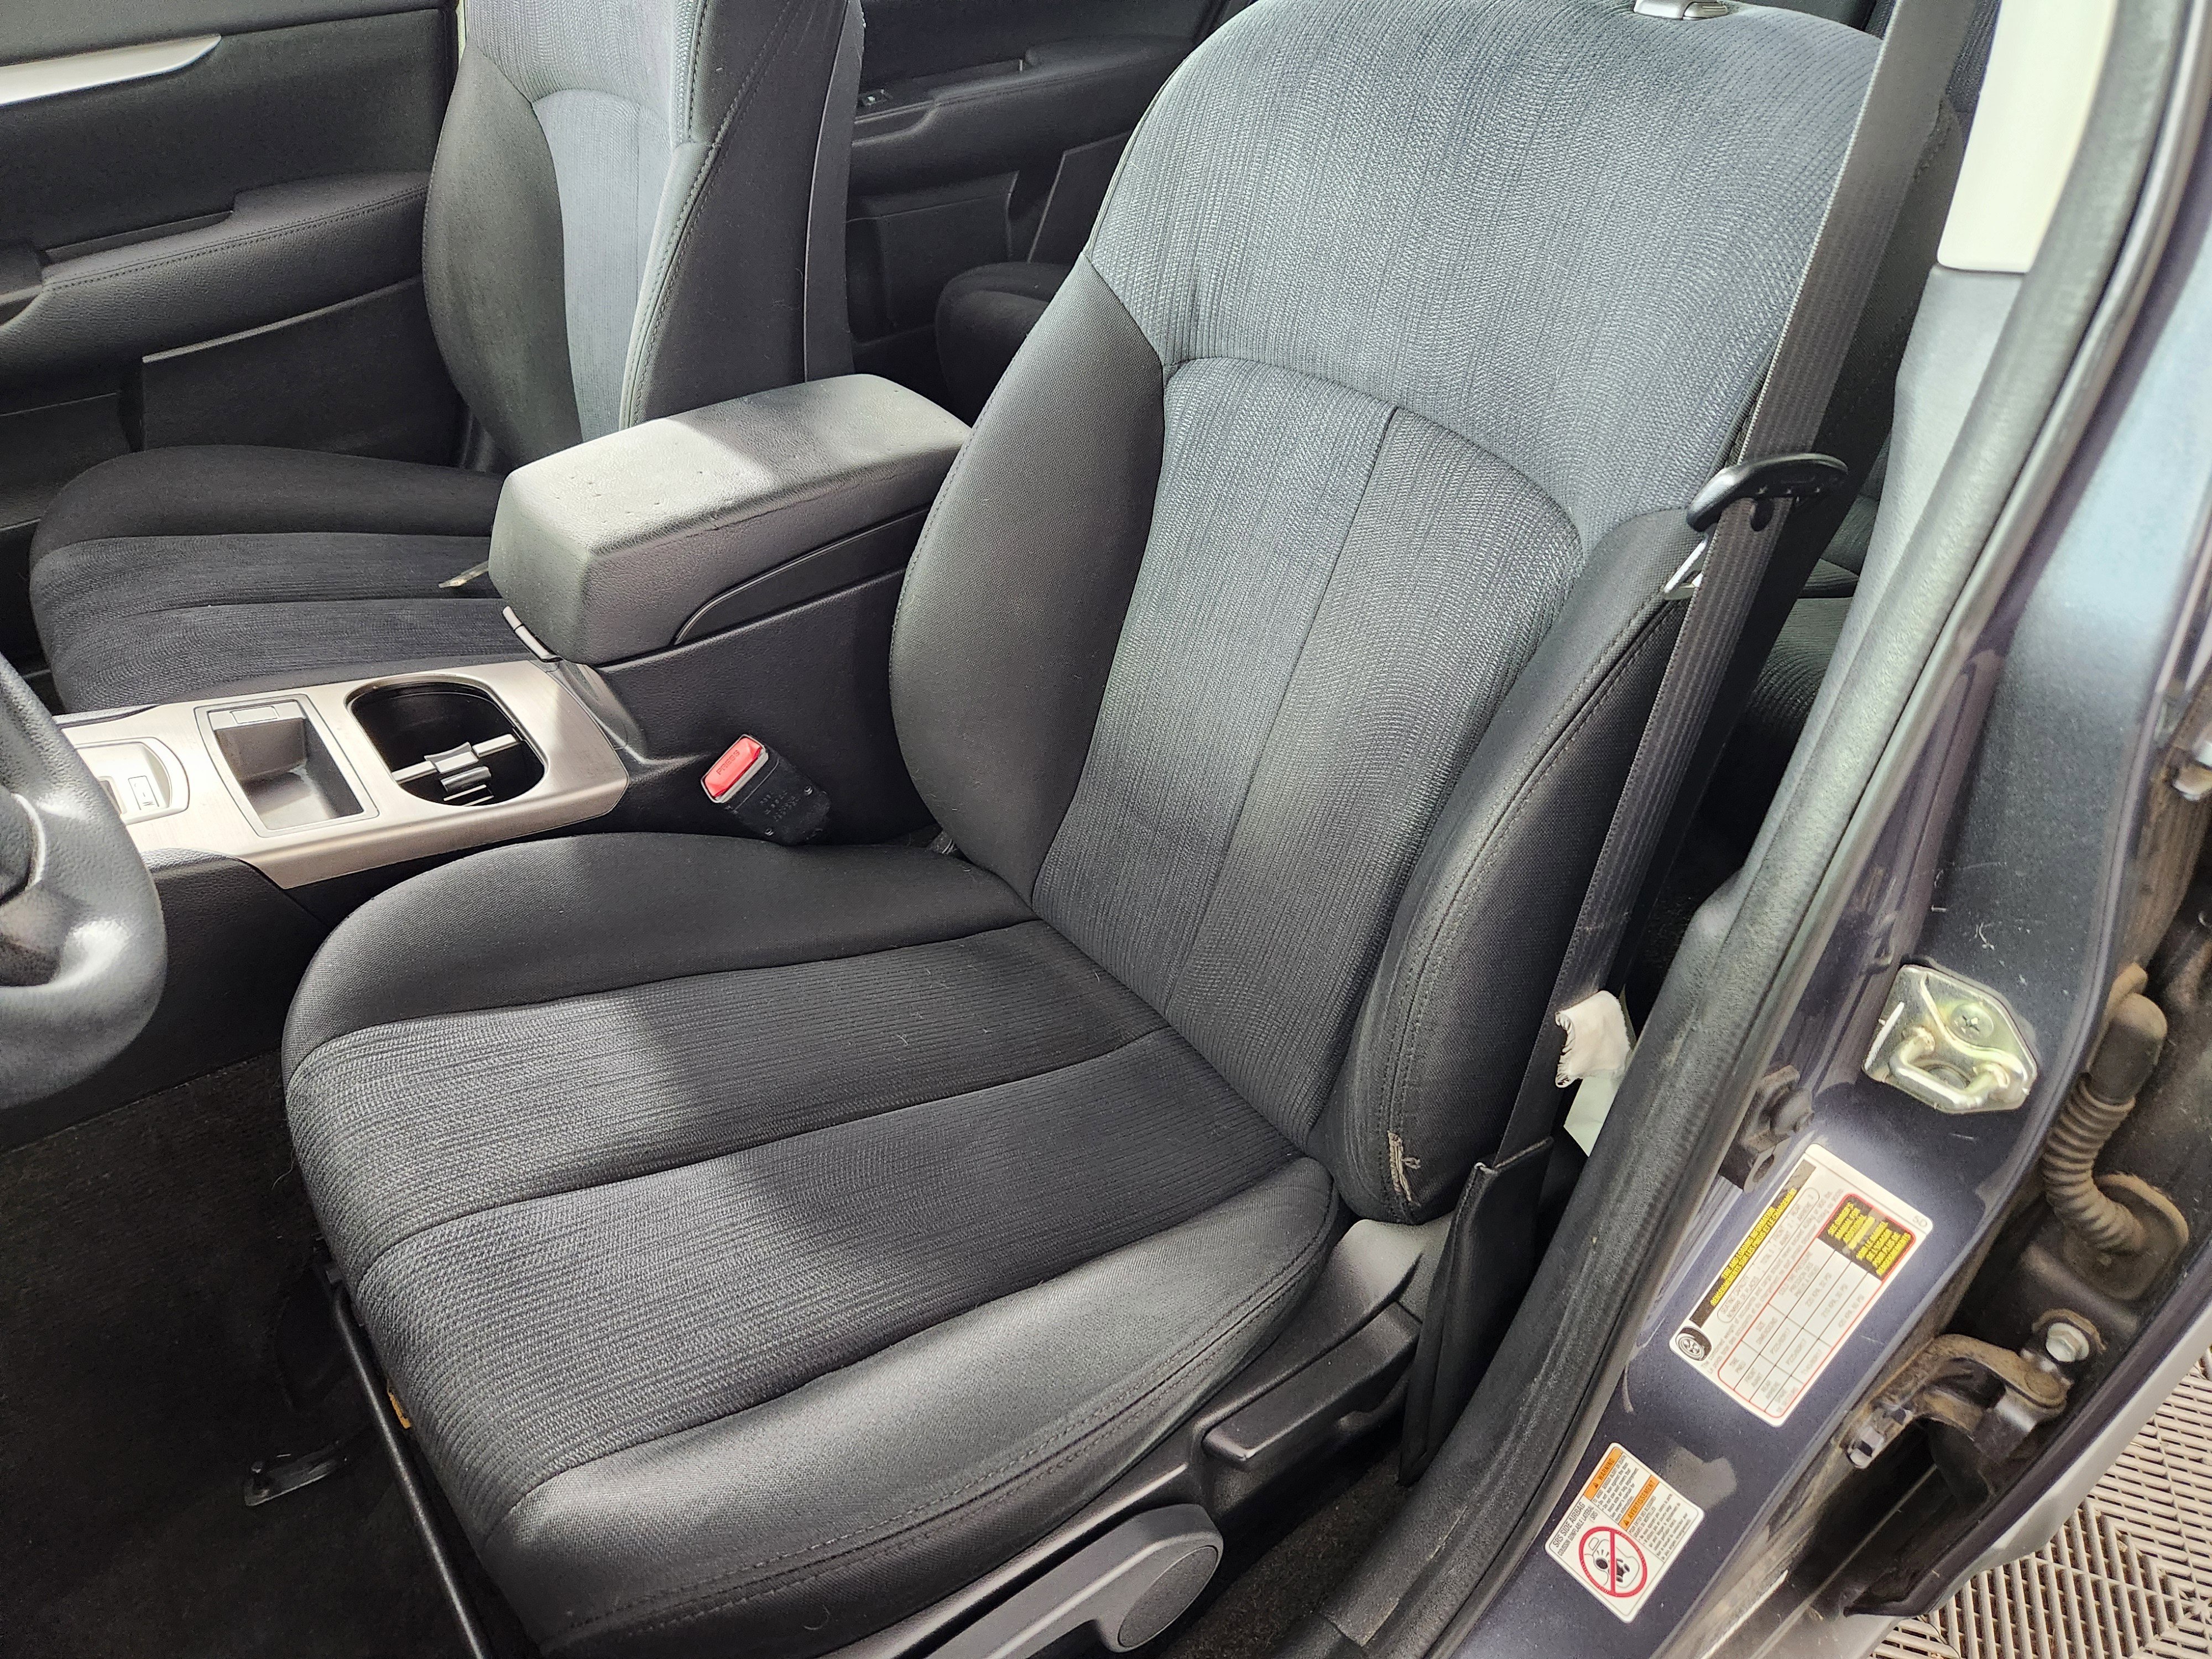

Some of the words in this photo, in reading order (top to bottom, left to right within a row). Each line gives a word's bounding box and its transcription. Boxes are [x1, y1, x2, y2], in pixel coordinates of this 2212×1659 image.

[716, 749, 741, 775] PRESS
[1709, 1263, 1743, 1307] RENSEIGNEMENTS
[1737, 1254, 1750, 1267] SUR
[1744, 1244, 1756, 1257] LES
[1751, 1229, 1767, 1248] PNEUS
[1761, 1223, 1771, 1233] ET
[1766, 1217, 1776, 1227] LE
[1771, 1186, 1797, 1220] CHARGEMENT
[1720, 1266, 1733, 1280] TIRE
[1728, 1256, 1740, 1269] AND
[1735, 1236, 1754, 1259] LOADING
[1749, 1205, 1776, 1239] INFORMATION
[1826, 1222, 1839, 1236] SEE
[1597, 1457, 1615, 1481] WARNING
[1626, 1479, 1656, 1520] AVERTISSEMENT
[1552, 1533, 1564, 1548] SRS
[1559, 1520, 1573, 1537] SIDE
[1568, 1500, 1586, 1524] AIRBAG
[1557, 1538, 1571, 1557] COUSSIN
[1567, 1518, 1585, 1541] GONFLABLE
